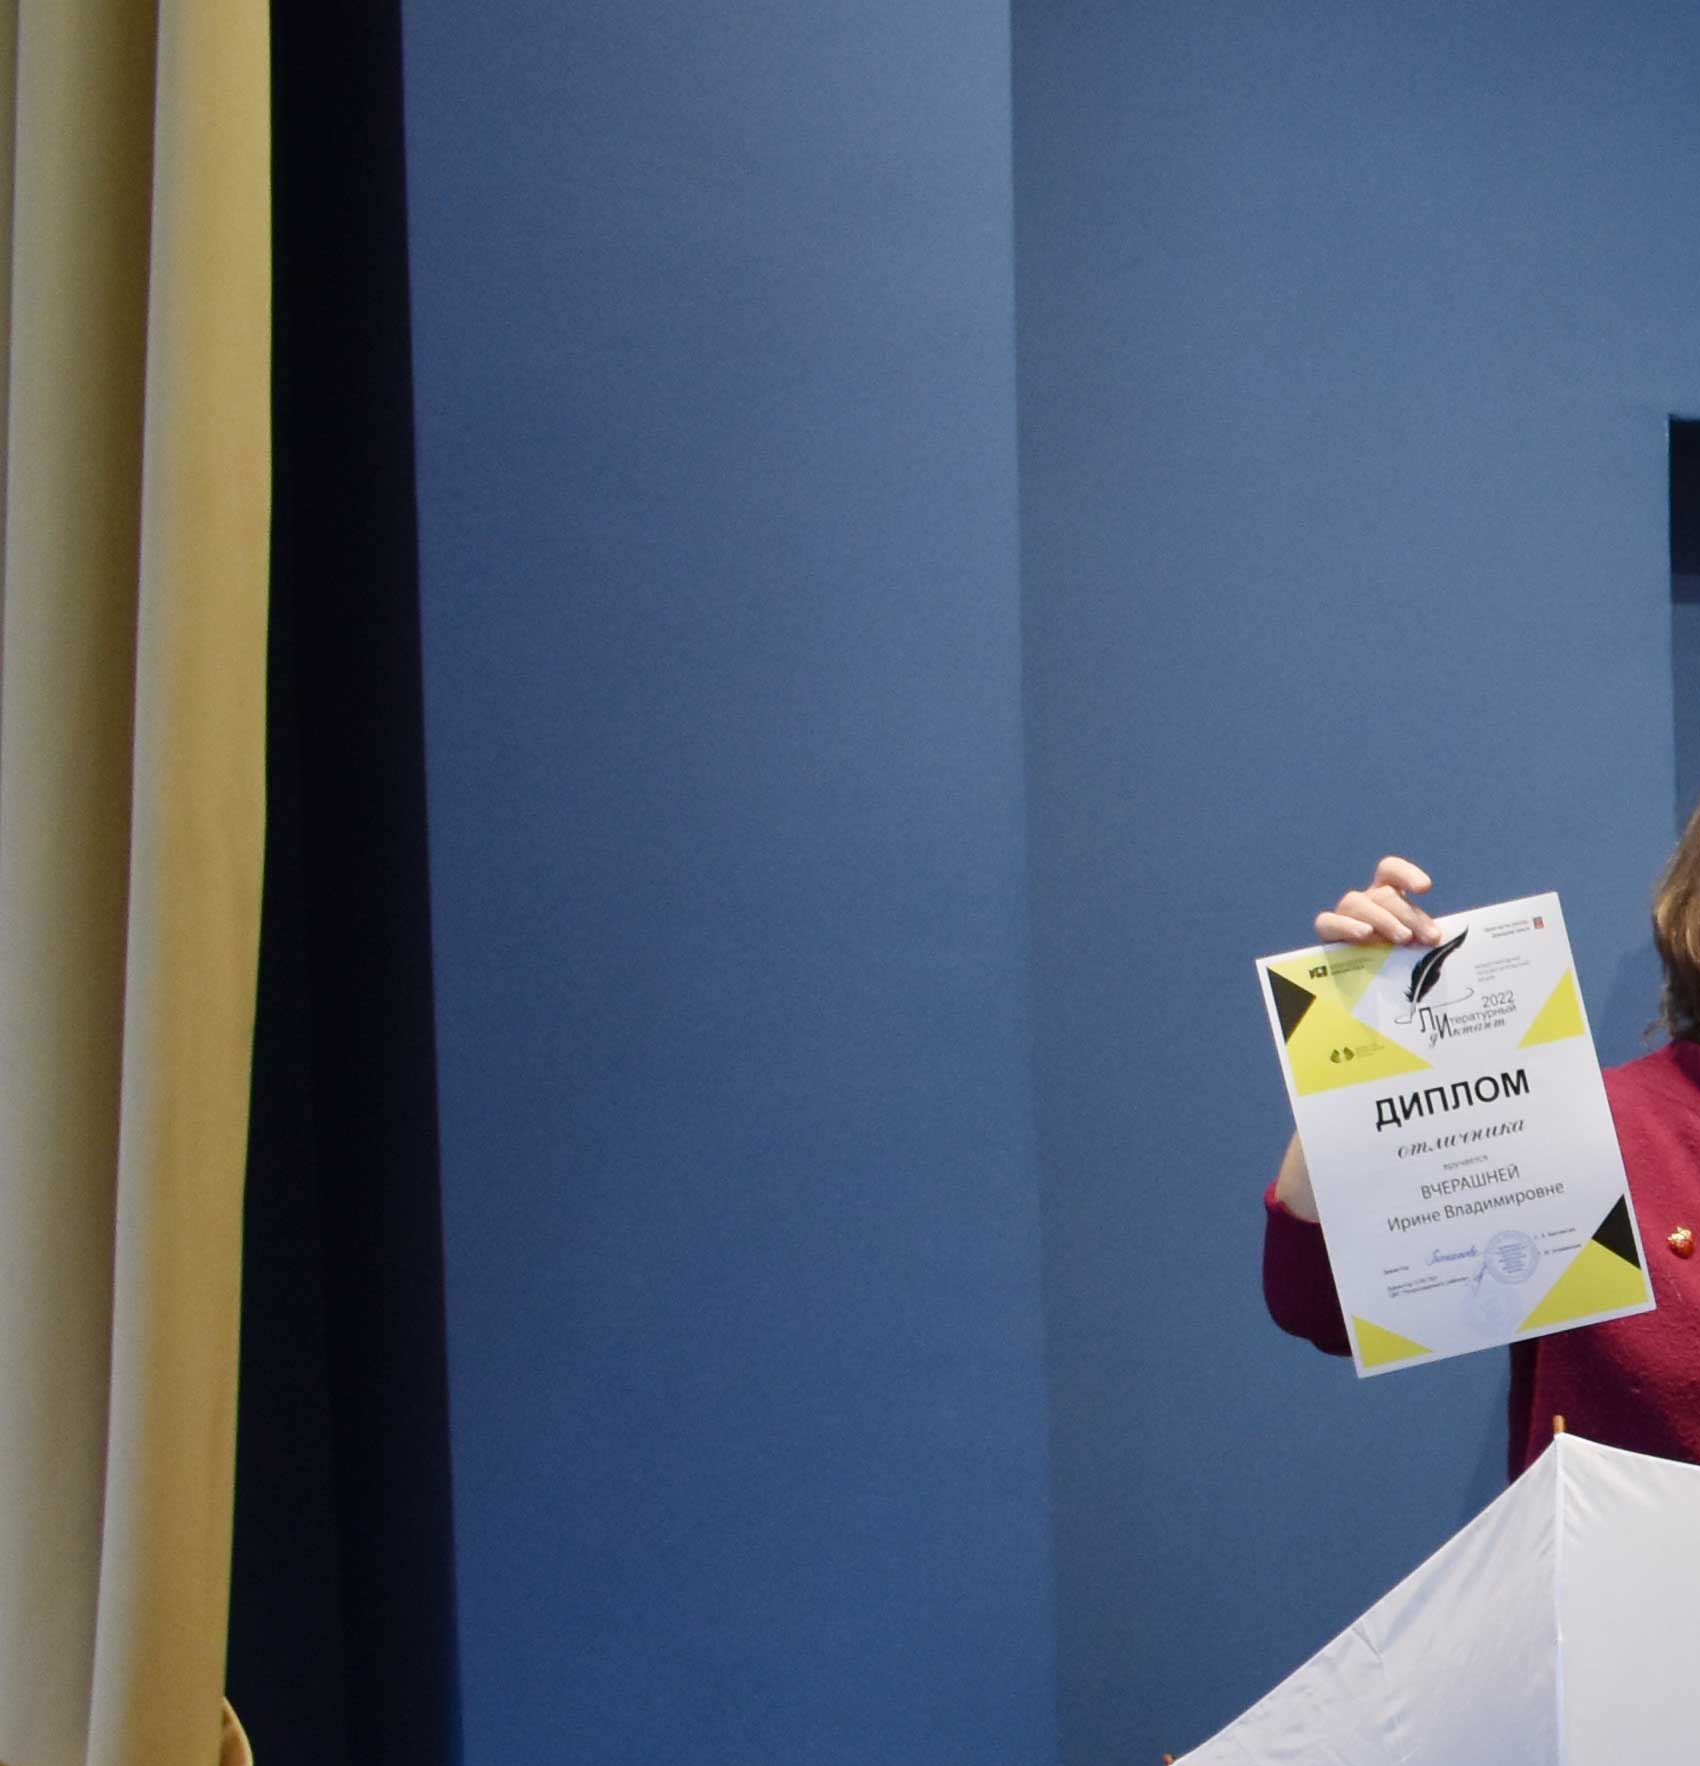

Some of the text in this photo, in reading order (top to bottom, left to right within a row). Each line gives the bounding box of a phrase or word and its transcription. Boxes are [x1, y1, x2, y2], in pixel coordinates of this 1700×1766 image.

[1481, 991, 1514, 1007] 2022
[1375, 1068, 1530, 1132] ДИПЛОМ
[1397, 1119, 1525, 1159] отличника
[1421, 1163, 1521, 1200] ВЧЕРАШНЕЙ
[1387, 1182, 1565, 1232] Ирине Владимировне
